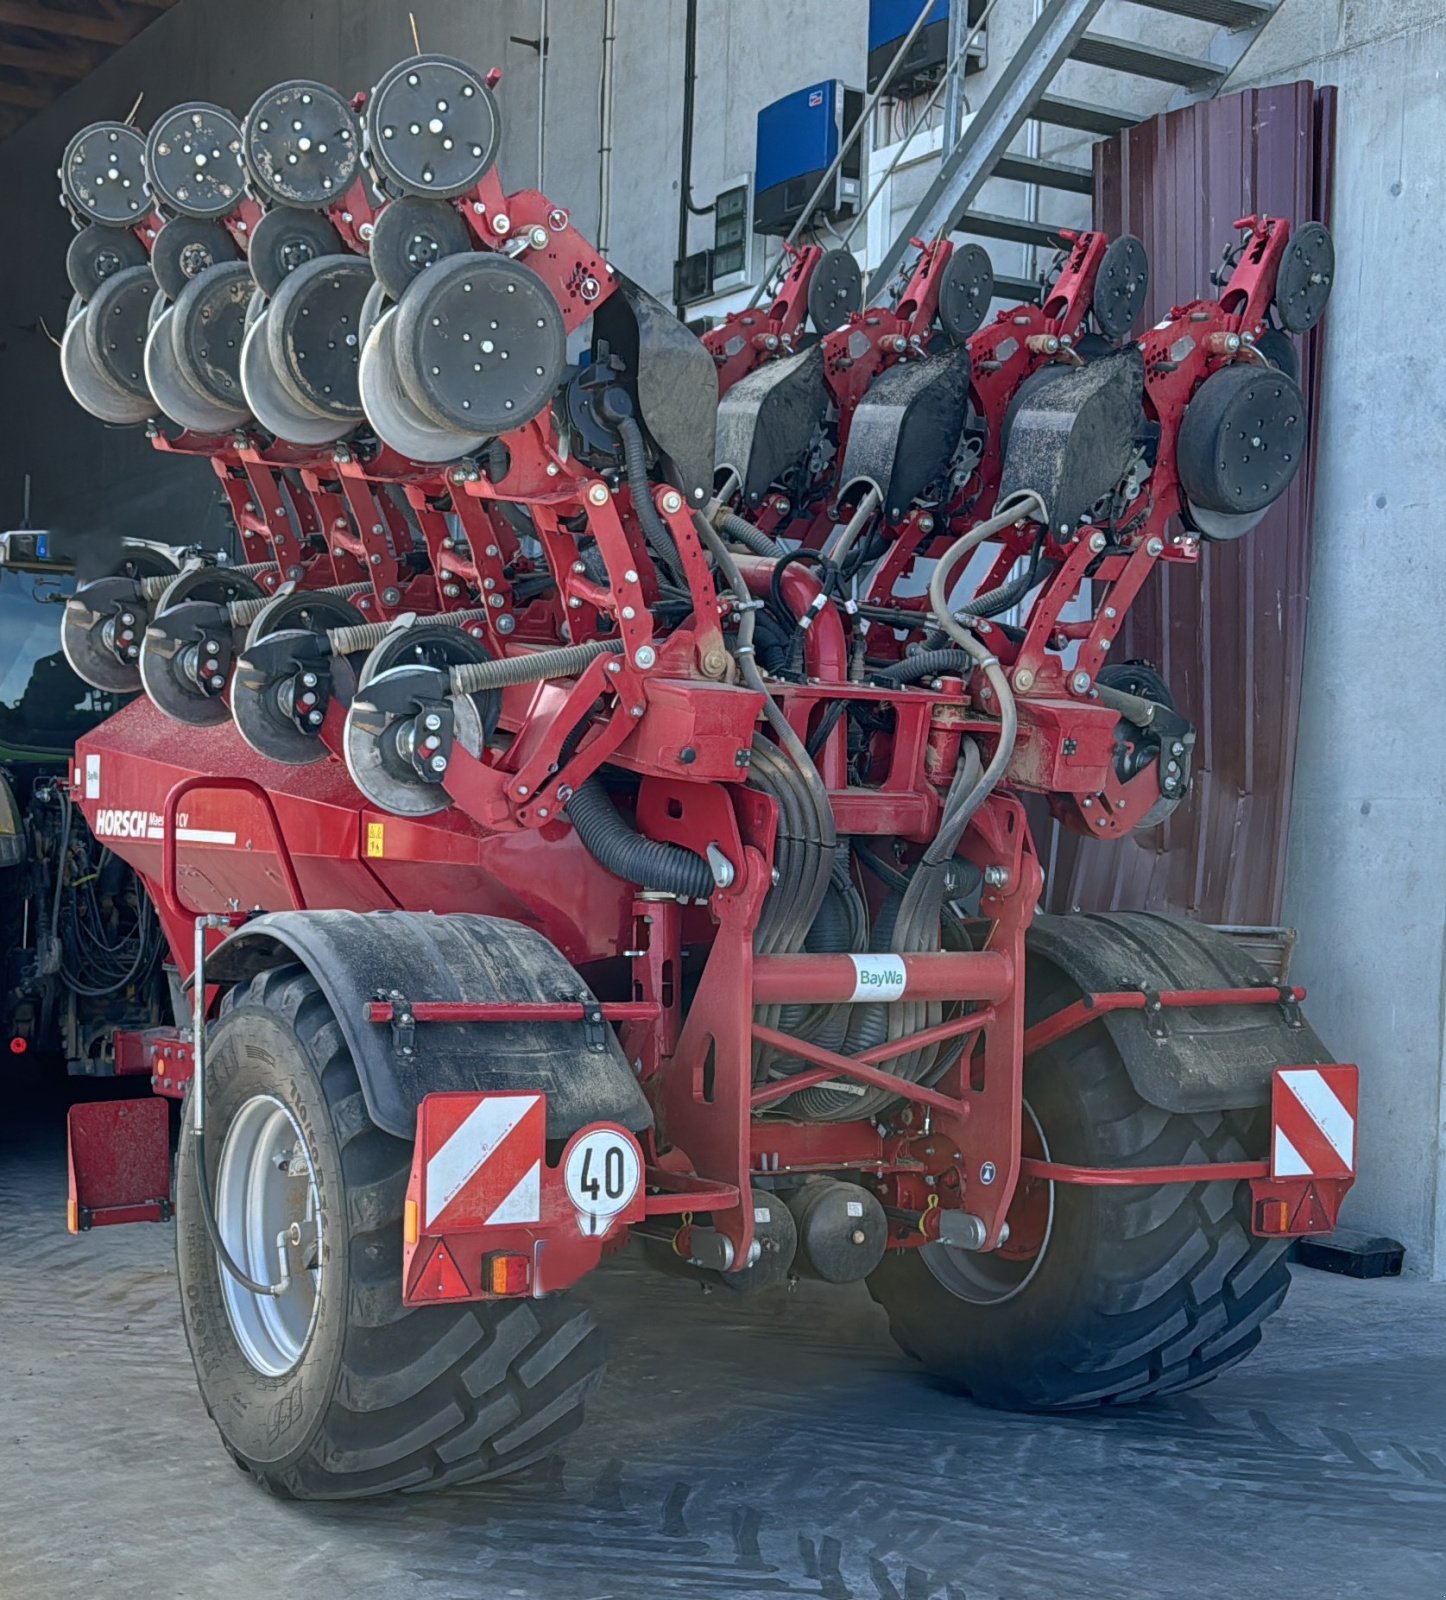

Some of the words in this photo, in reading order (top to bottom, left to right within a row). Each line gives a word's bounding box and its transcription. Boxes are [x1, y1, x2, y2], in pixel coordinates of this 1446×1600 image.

[95, 809, 148, 838] HORSCH
[860, 970, 903, 987] BayWa
[580, 1146, 624, 1200] 40
